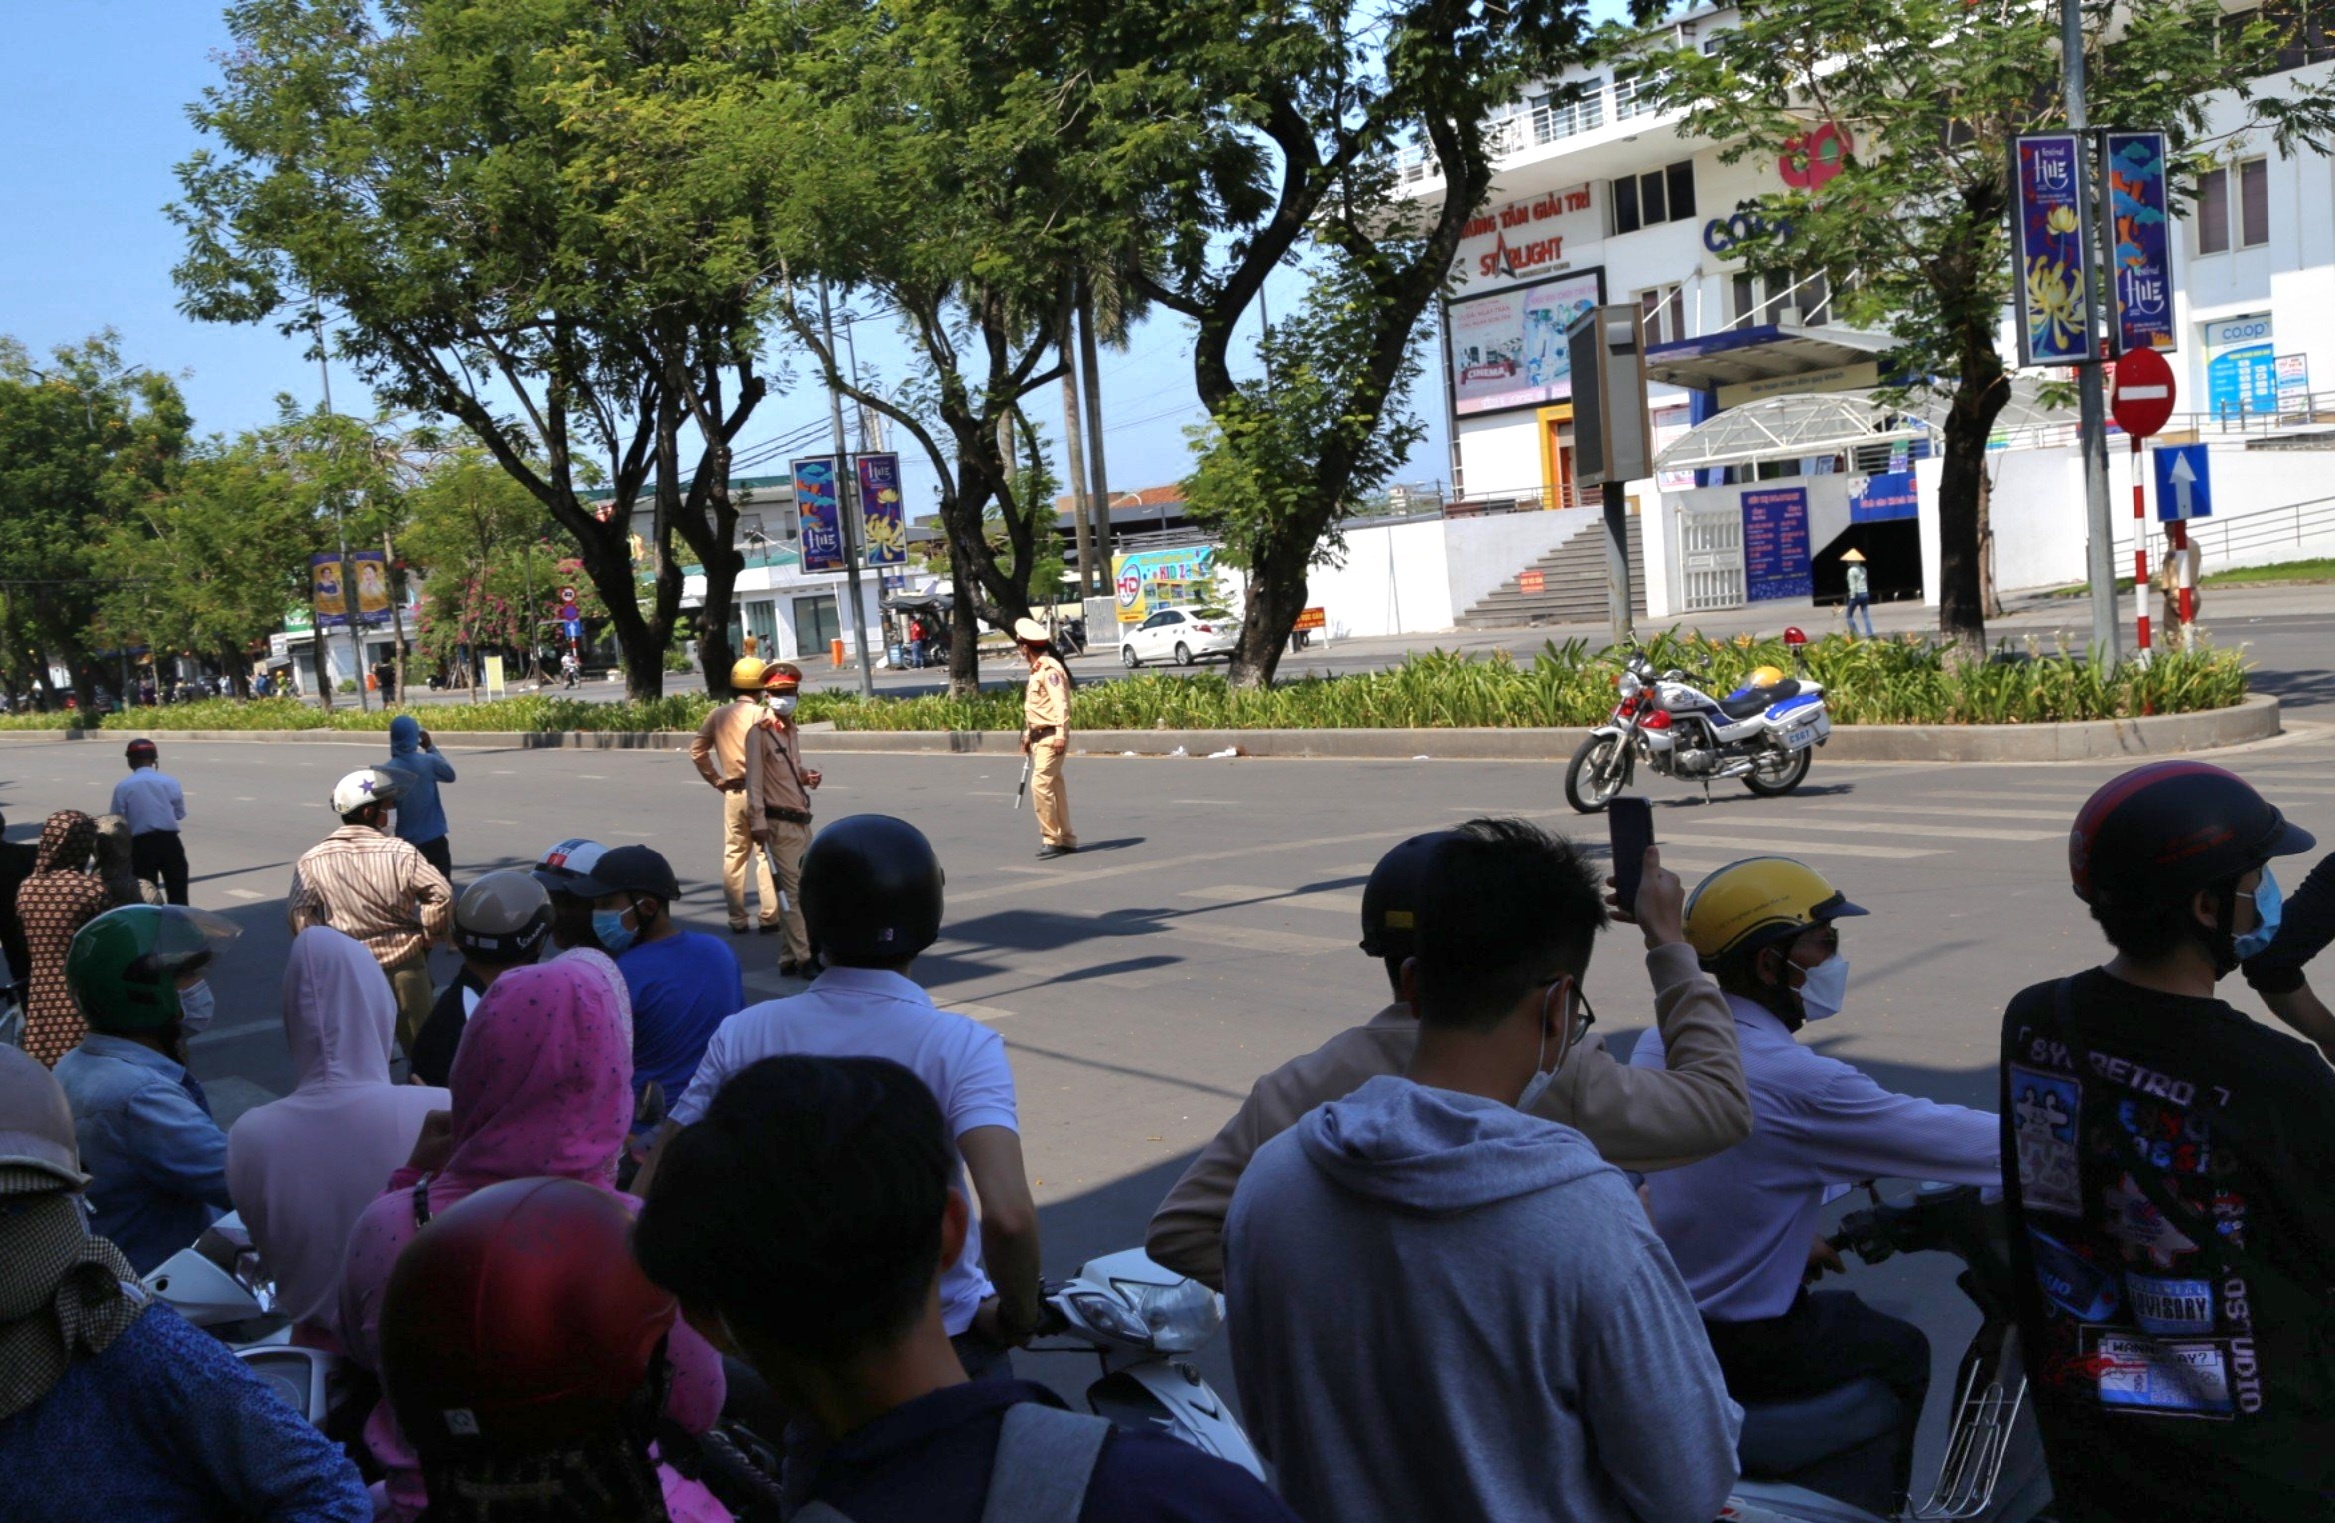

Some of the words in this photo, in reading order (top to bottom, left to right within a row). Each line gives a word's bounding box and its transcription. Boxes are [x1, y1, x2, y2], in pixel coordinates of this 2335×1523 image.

[1461, 215, 1497, 240] RUNG
[1499, 203, 1530, 229] TÂM
[1480, 230, 1563, 279] STARLIGHT
[1467, 366, 1505, 379] CINEMA
[1160, 565, 1177, 580] KID
[2112, 1340, 2156, 1354] WANN
